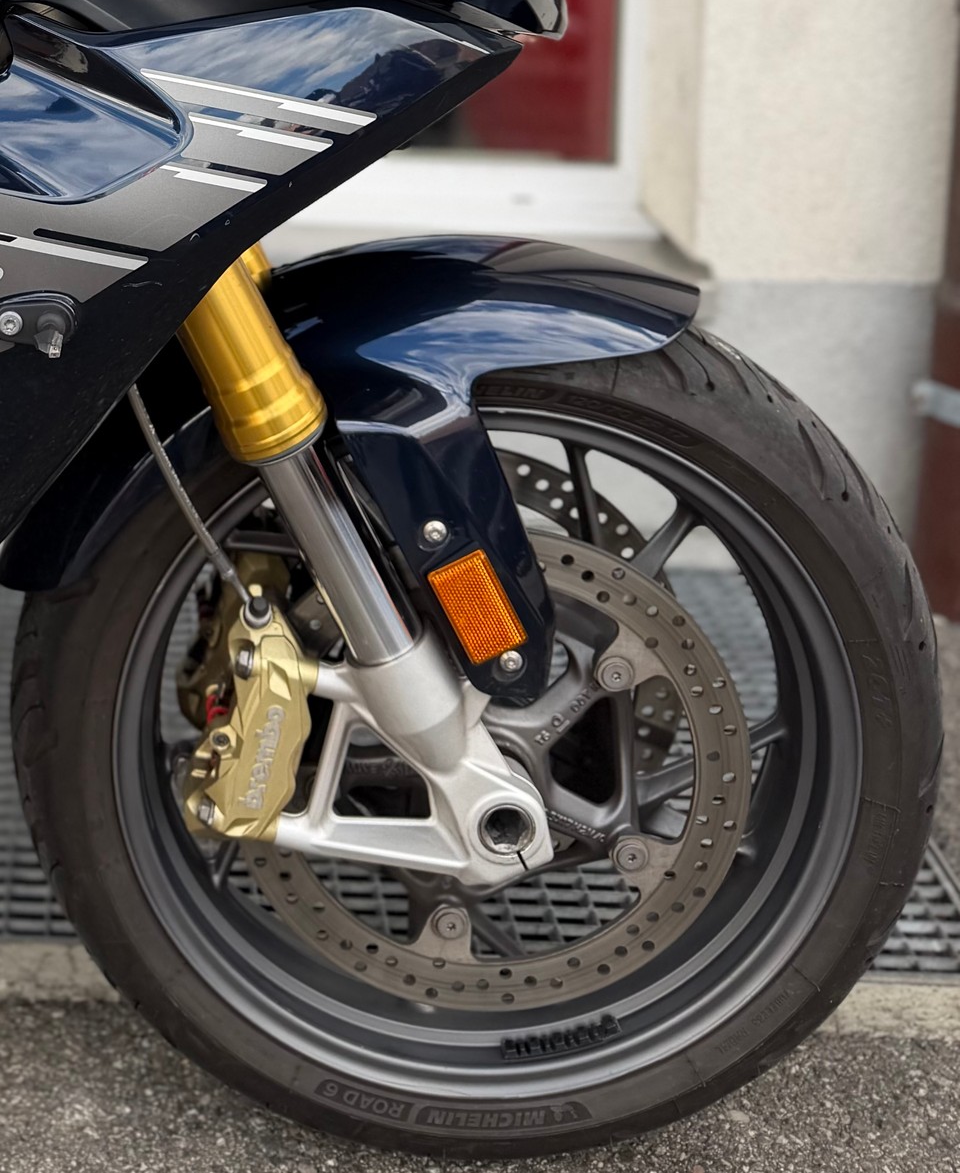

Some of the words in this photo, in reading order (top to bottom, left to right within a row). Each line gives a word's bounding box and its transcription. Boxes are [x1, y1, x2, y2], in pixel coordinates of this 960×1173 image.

[239, 704, 286, 810] brembo
[323, 1081, 339, 1098] 6
[342, 1090, 406, 1119] ROAD
[425, 1108, 547, 1128] MICHELIN
